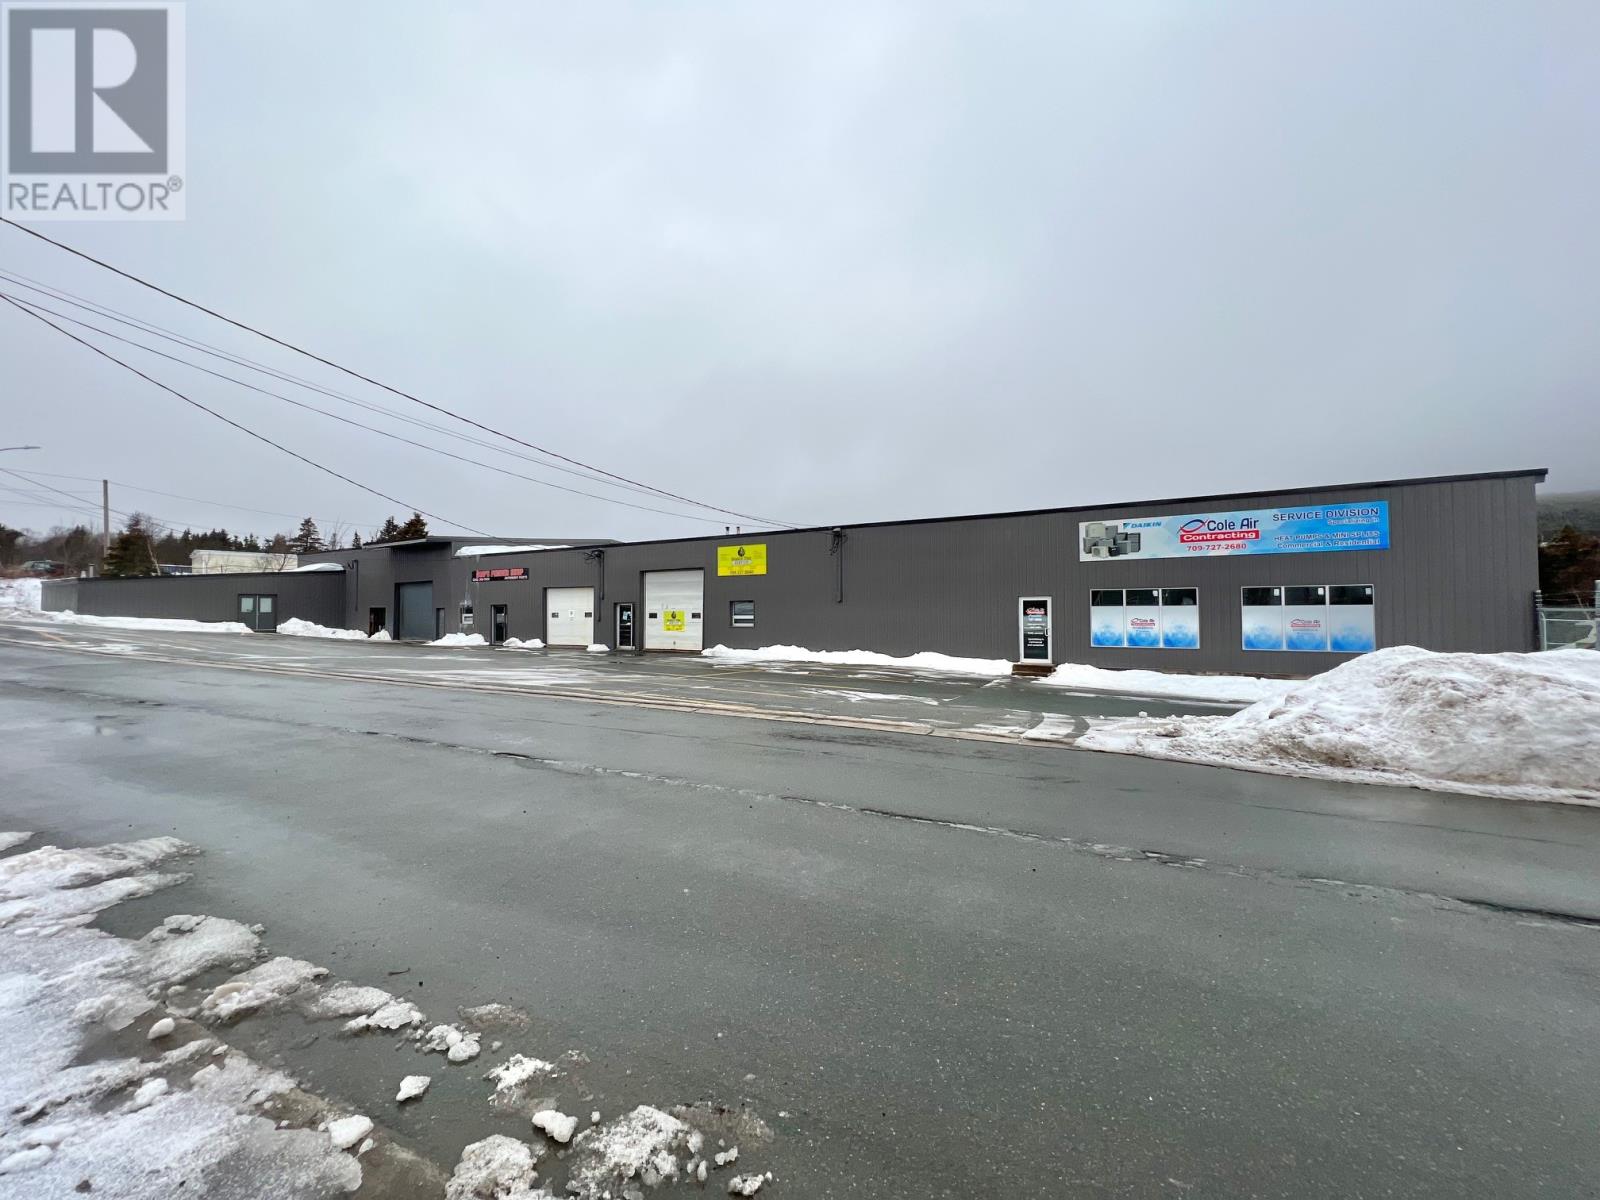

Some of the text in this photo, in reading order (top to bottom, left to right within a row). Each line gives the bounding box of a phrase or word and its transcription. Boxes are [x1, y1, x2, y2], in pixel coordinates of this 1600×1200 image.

[1272, 507, 1380, 522] SERVICE DIVISION
[1130, 521, 1162, 529] DAIKIN
[1207, 517, 1260, 531] Cole Air
[1183, 532, 1256, 541] Contracting
[1186, 543, 1247, 552] 709-727-2680
